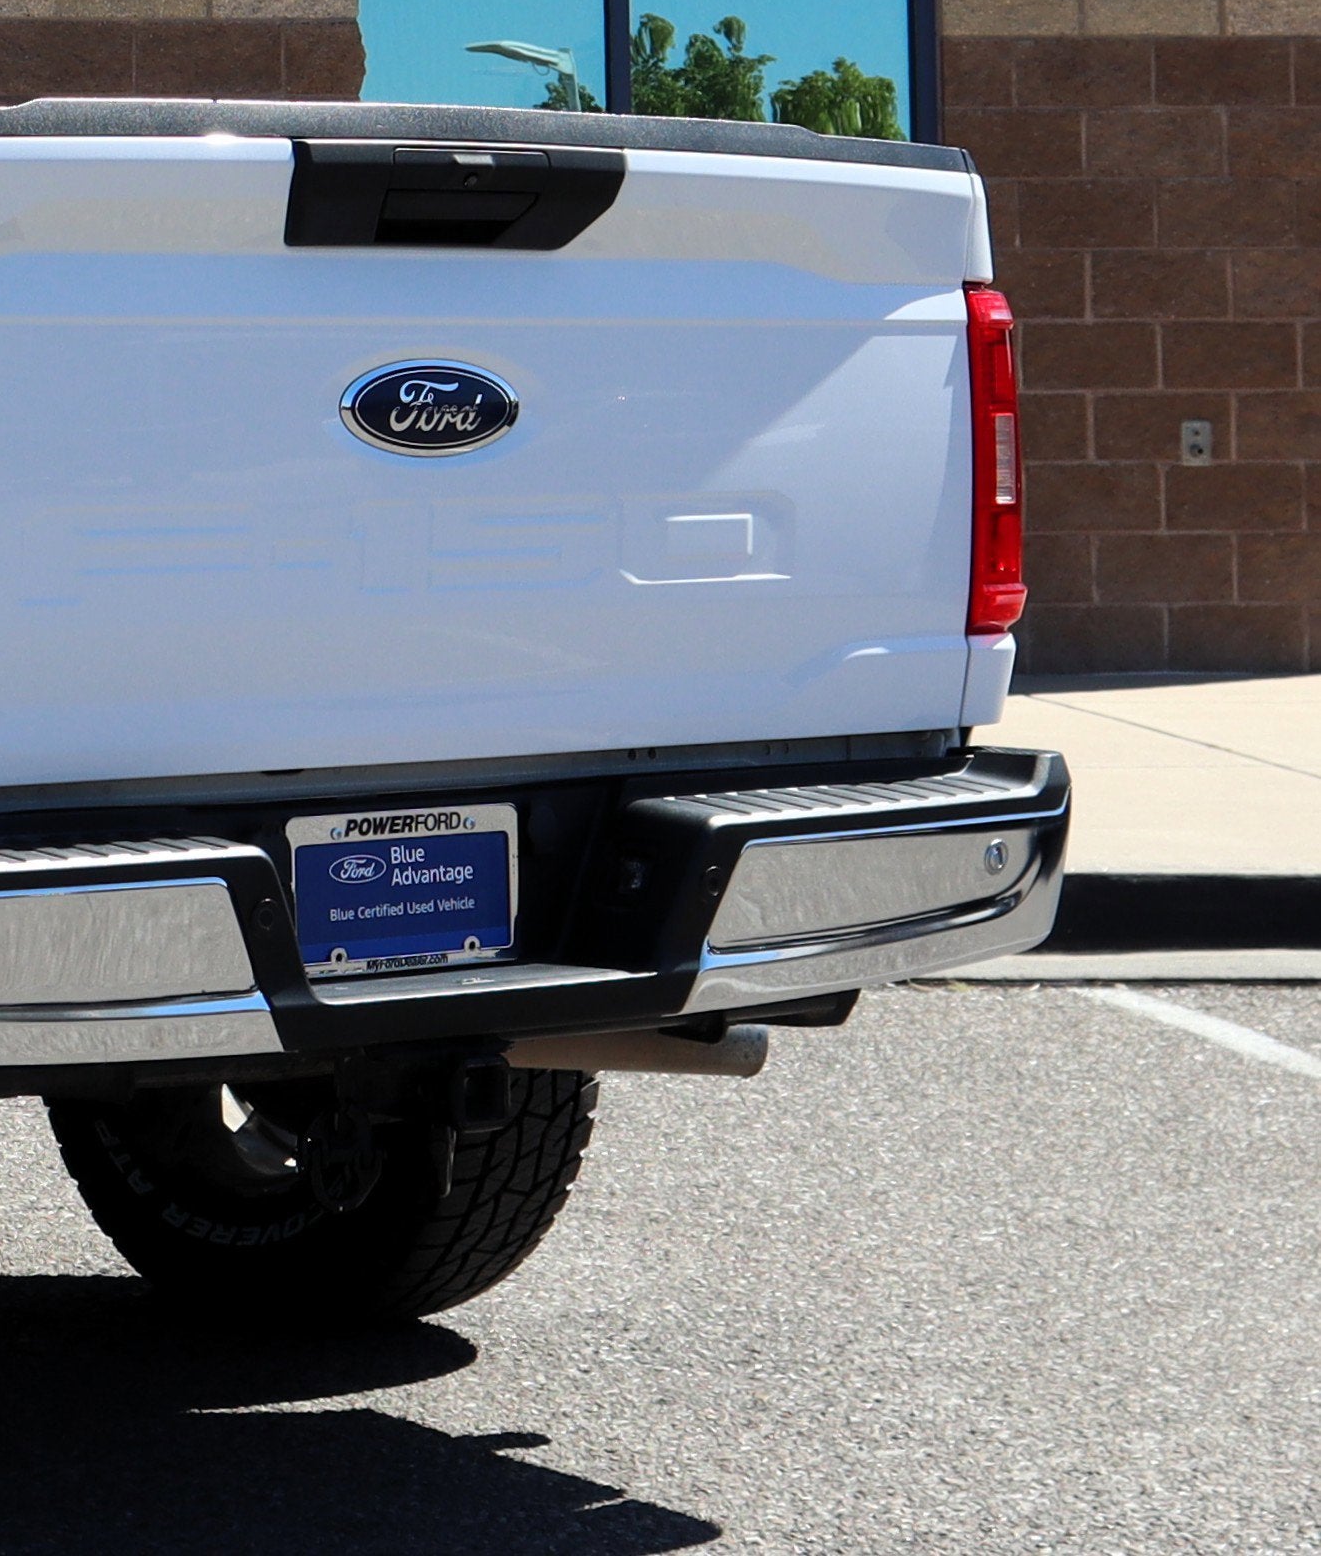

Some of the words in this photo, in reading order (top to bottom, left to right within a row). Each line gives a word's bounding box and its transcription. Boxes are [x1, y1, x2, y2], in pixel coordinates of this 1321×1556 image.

[388, 379, 484, 433] Ford
[343, 811, 462, 839] POWERFORD
[390, 844, 426, 865] Blue
[339, 857, 376, 881] Ford
[390, 862, 474, 887] Advantage
[329, 907, 355, 922] Blue
[357, 902, 404, 921] Certified
[408, 898, 434, 915] Used
[437, 895, 476, 912] Vehicle
